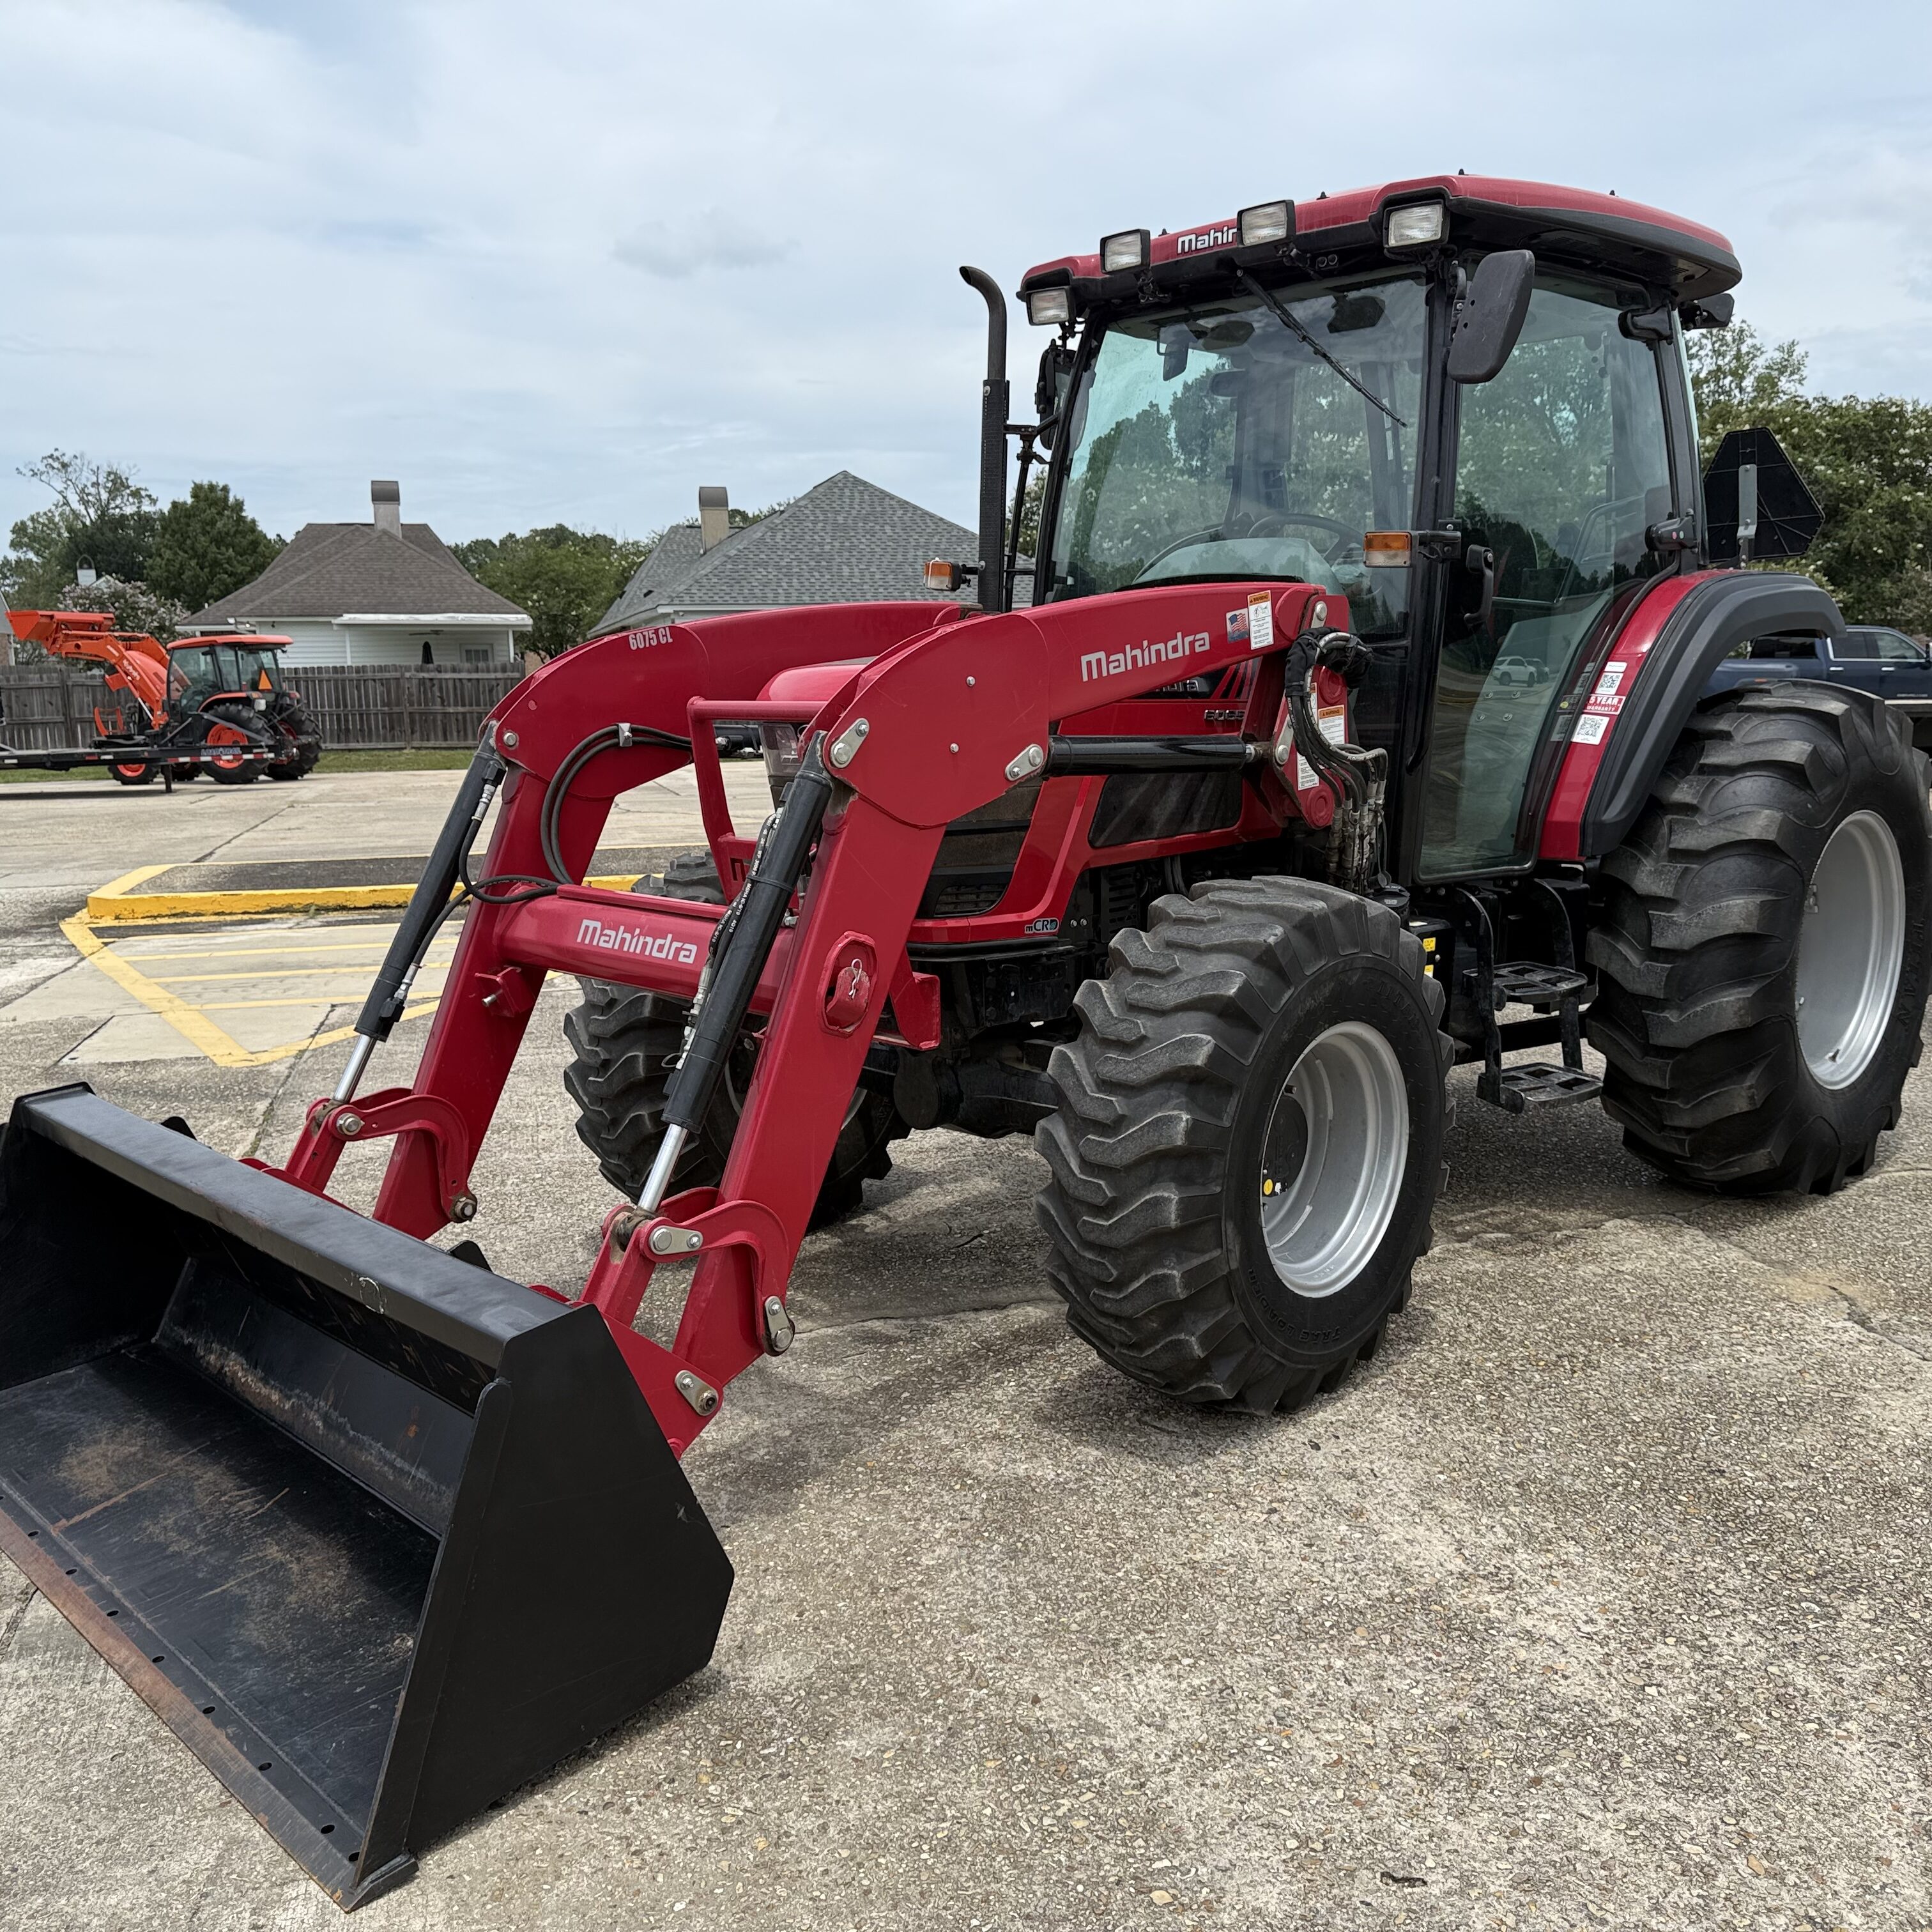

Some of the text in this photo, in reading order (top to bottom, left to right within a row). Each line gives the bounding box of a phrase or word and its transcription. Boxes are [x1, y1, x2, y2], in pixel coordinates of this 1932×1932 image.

[629, 627, 673, 650] 6075 CL
[1081, 631, 1210, 682] Mahindra
[577, 919, 698, 964] Mahindra
[1248, 1268, 1296, 1336] LOADER
